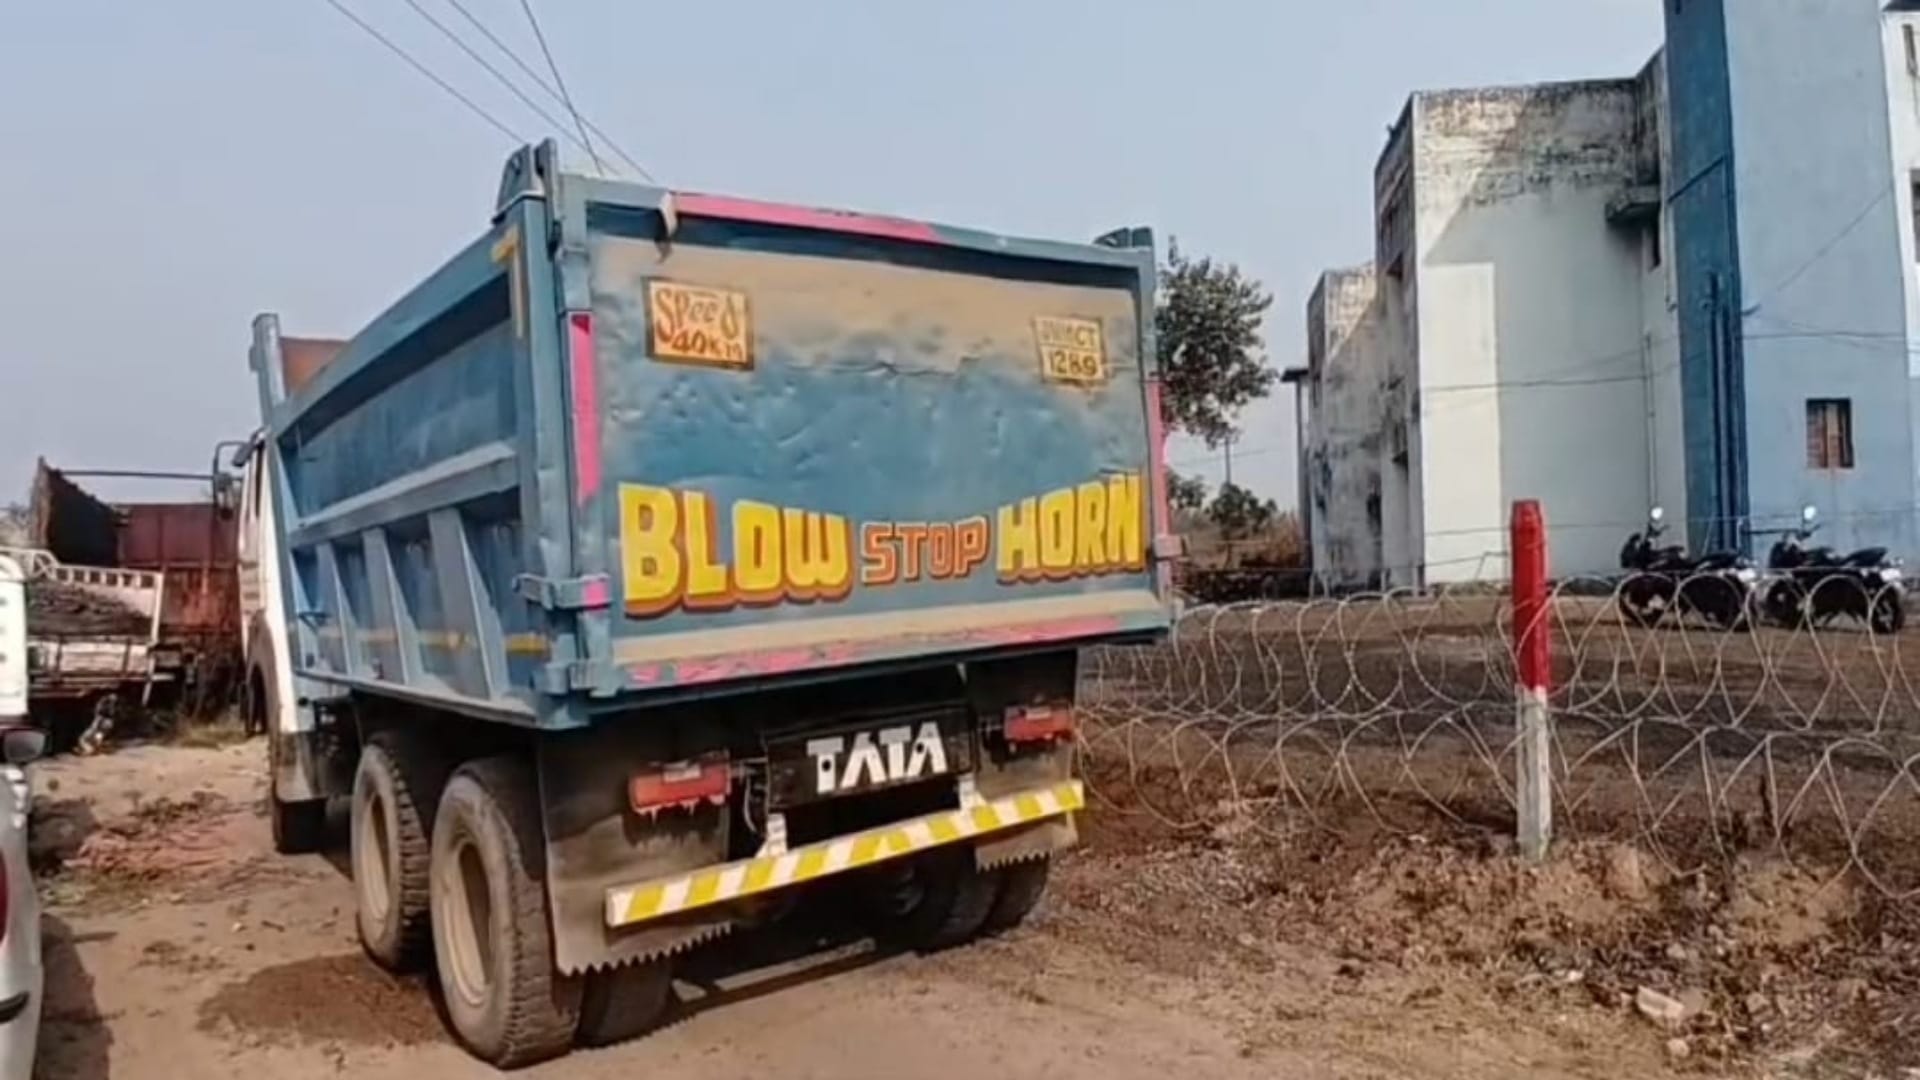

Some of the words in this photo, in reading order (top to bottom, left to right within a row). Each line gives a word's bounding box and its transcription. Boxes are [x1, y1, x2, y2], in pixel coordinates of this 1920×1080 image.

[618, 482, 853, 617] BLOW
[861, 515, 989, 586] STOP
[996, 473, 1144, 584] HORN
[806, 720, 948, 794] TATA
